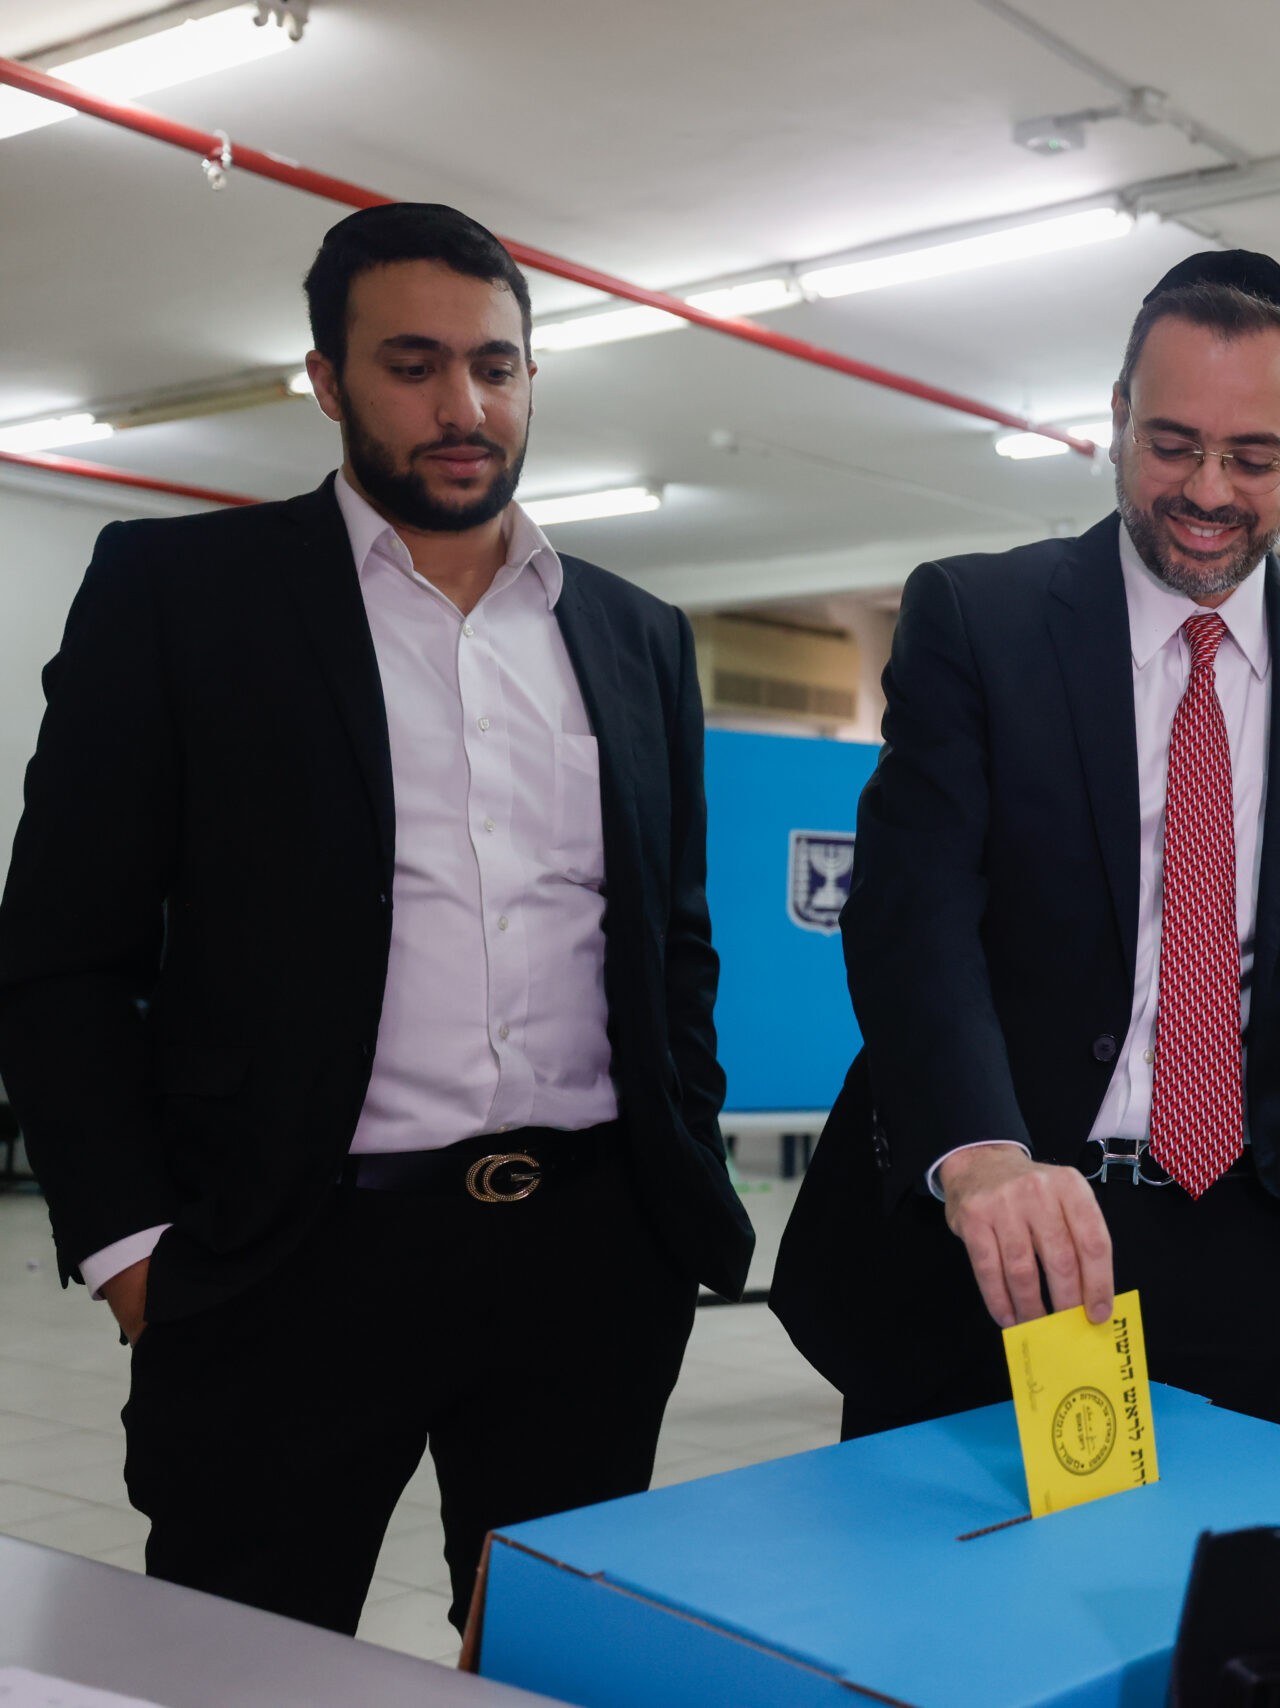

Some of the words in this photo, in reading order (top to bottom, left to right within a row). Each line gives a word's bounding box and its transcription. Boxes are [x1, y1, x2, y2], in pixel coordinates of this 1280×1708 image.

[1113, 1317, 1134, 1381] הרשות
[1056, 1400, 1072, 1439] הפנים
[1123, 1386, 1144, 1442] לראש
